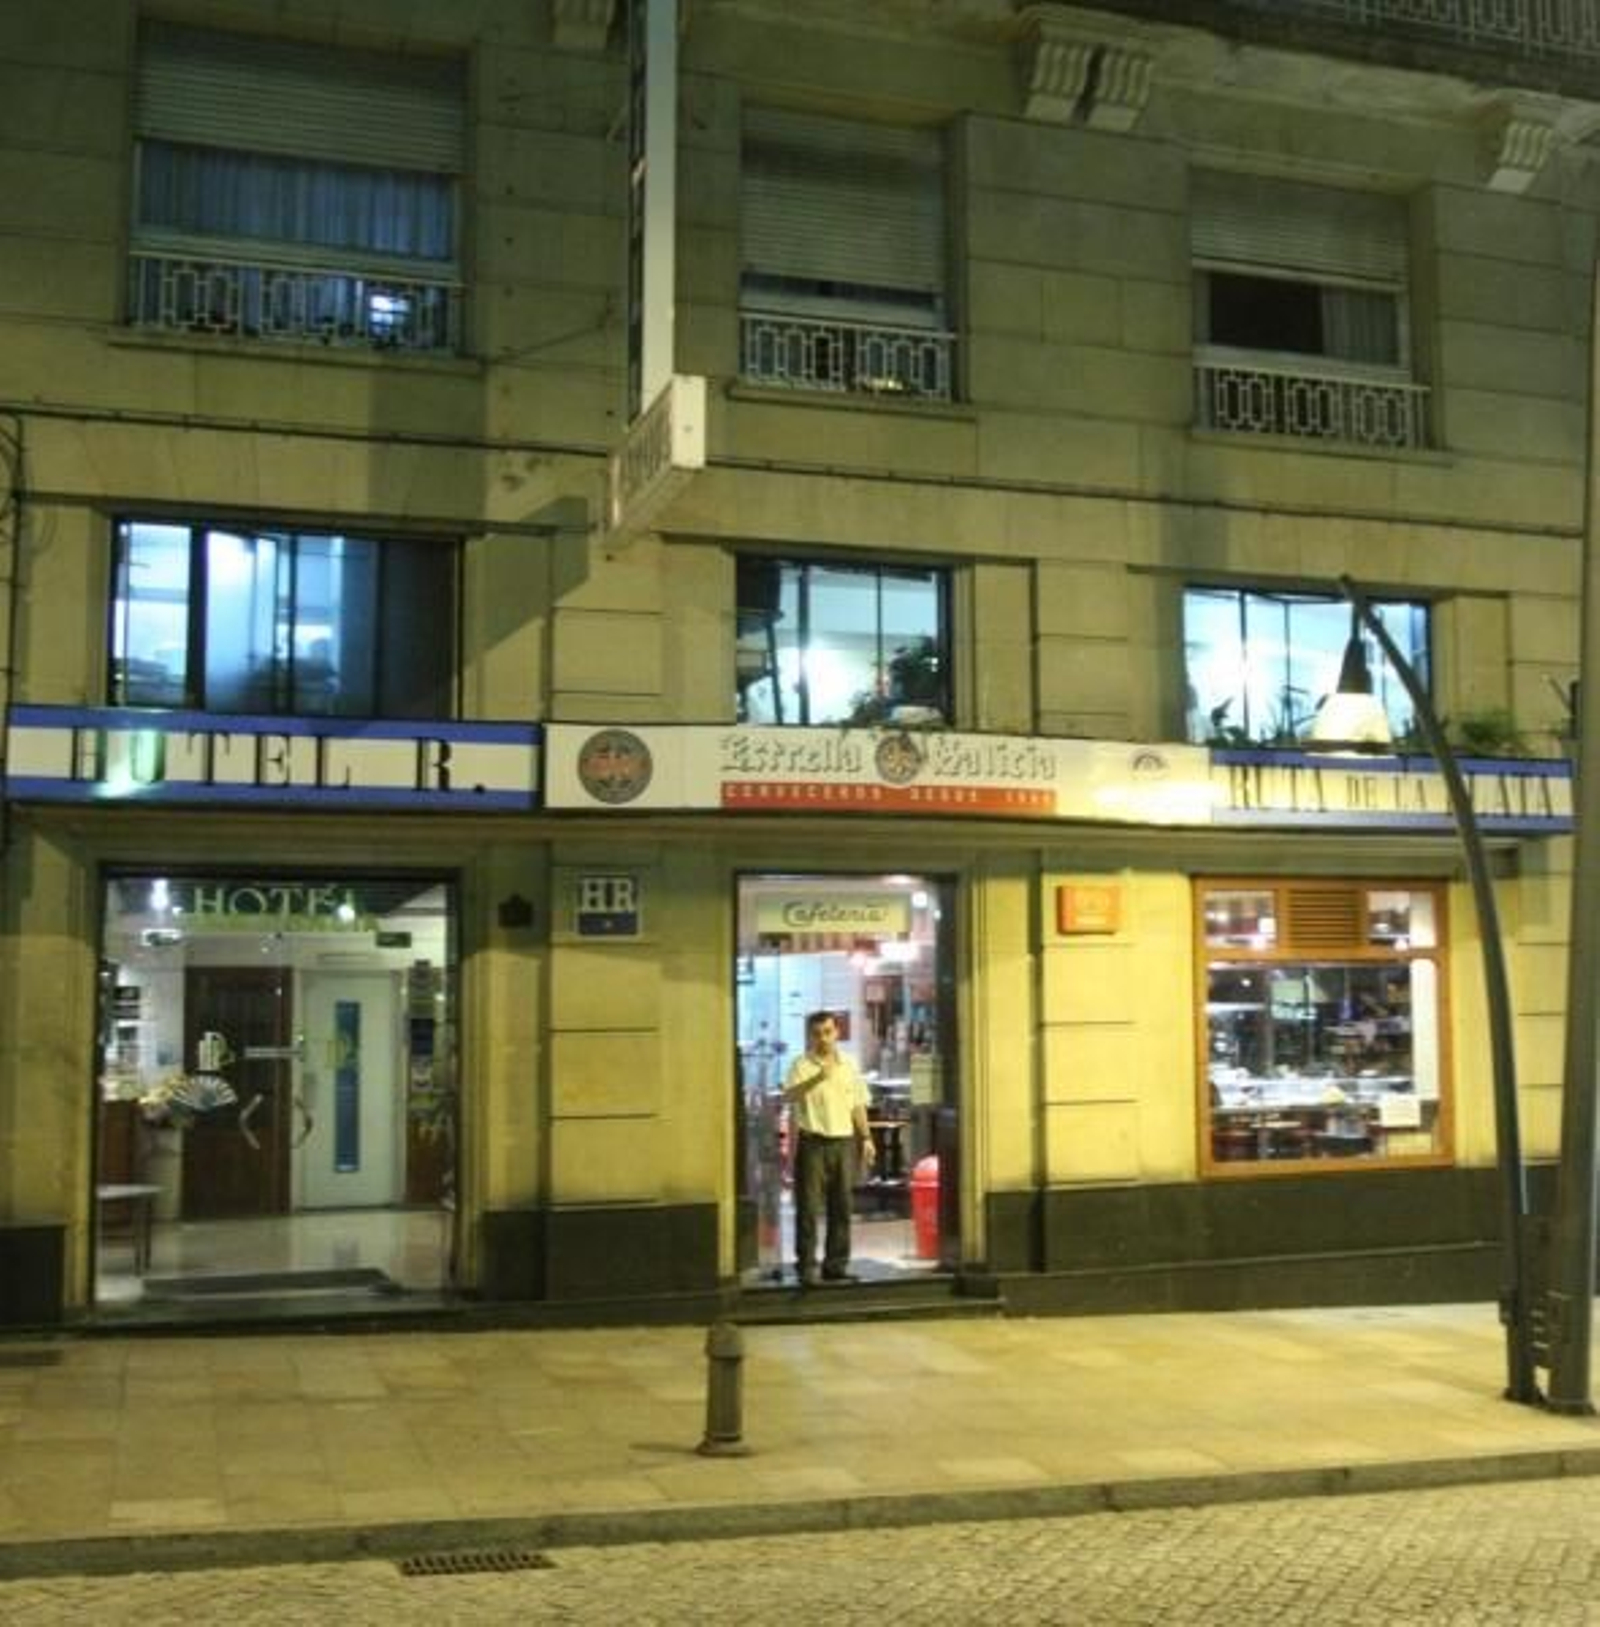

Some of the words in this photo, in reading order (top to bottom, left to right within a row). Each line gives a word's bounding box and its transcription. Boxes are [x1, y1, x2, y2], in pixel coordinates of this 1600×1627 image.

[70, 726, 350, 788] HOTEL
[415, 736, 486, 794] R.
[1346, 774, 1377, 809] DE
[1443, 770, 1555, 819] LATA
[581, 878, 635, 912] HR
